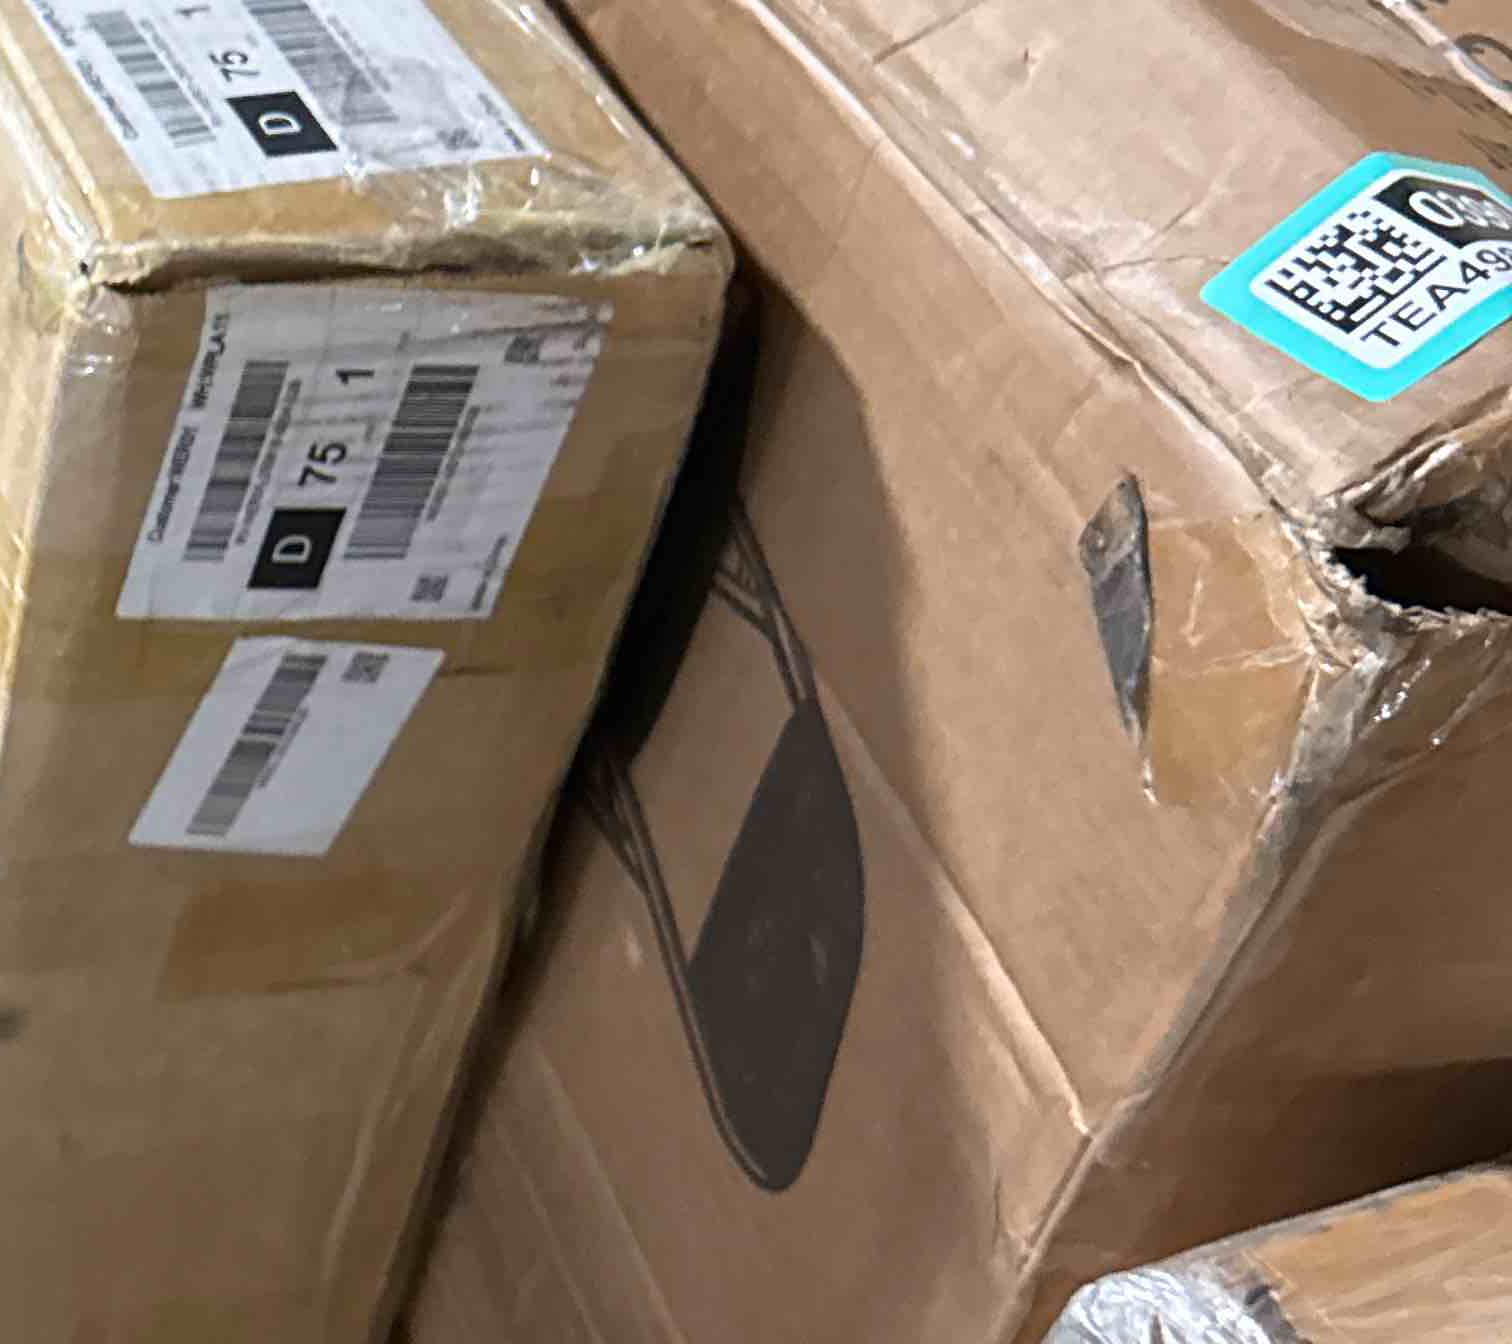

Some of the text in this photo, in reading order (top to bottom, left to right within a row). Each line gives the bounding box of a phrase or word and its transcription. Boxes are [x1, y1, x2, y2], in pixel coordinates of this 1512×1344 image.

[208, 50, 261, 83] 75
[258, 112, 302, 136] D
[271, 368, 376, 564] D 75 1
